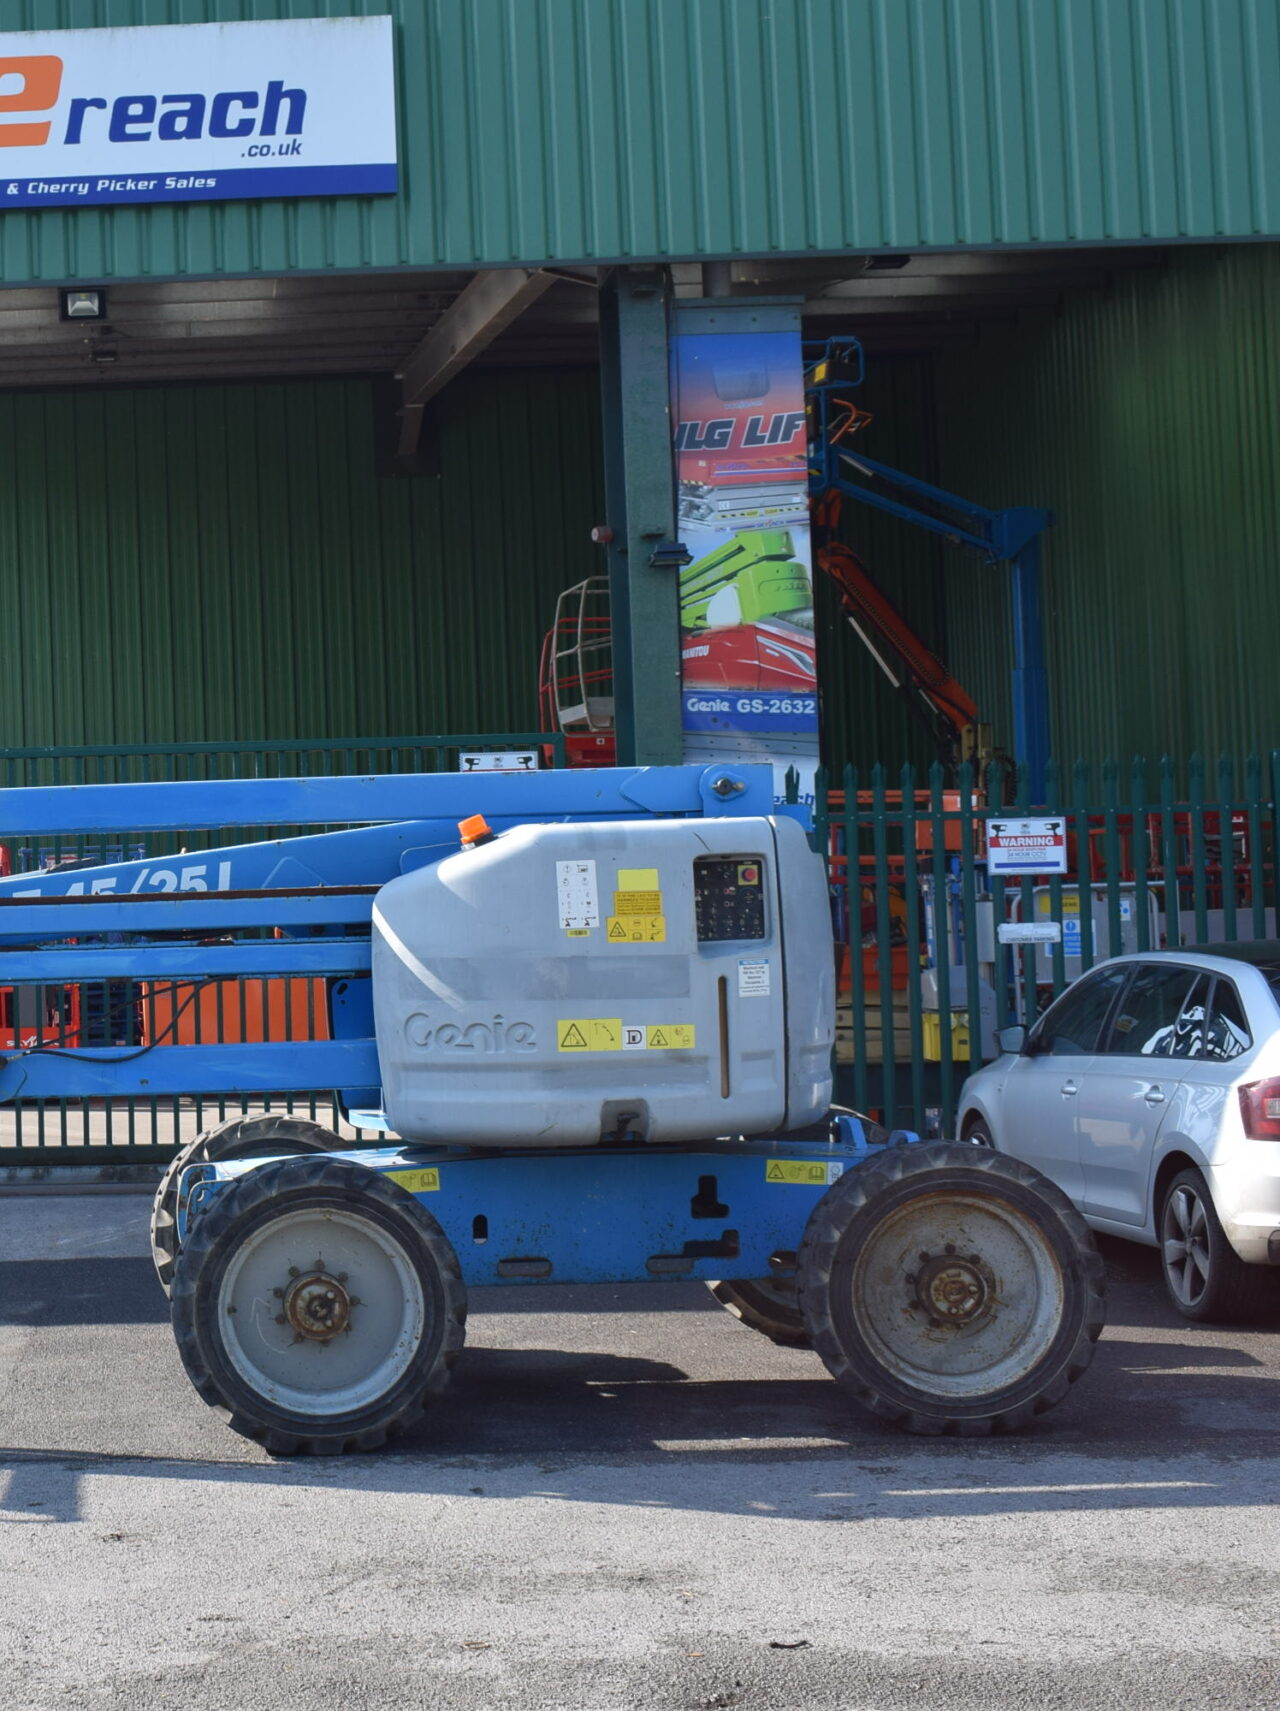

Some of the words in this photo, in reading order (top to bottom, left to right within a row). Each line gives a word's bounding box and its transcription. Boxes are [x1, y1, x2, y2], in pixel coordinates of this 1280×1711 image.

[240, 140, 303, 159] .co.uk
[7, 181, 19, 196] &
[26, 178, 89, 197] Cherry
[96, 176, 158, 192] Picker
[165, 174, 217, 189] Sales
[687, 698, 729, 712] Genie
[736, 699, 816, 713] GS-2632
[999, 836, 1054, 847] WARNING
[404, 1012, 538, 1053] Genie
